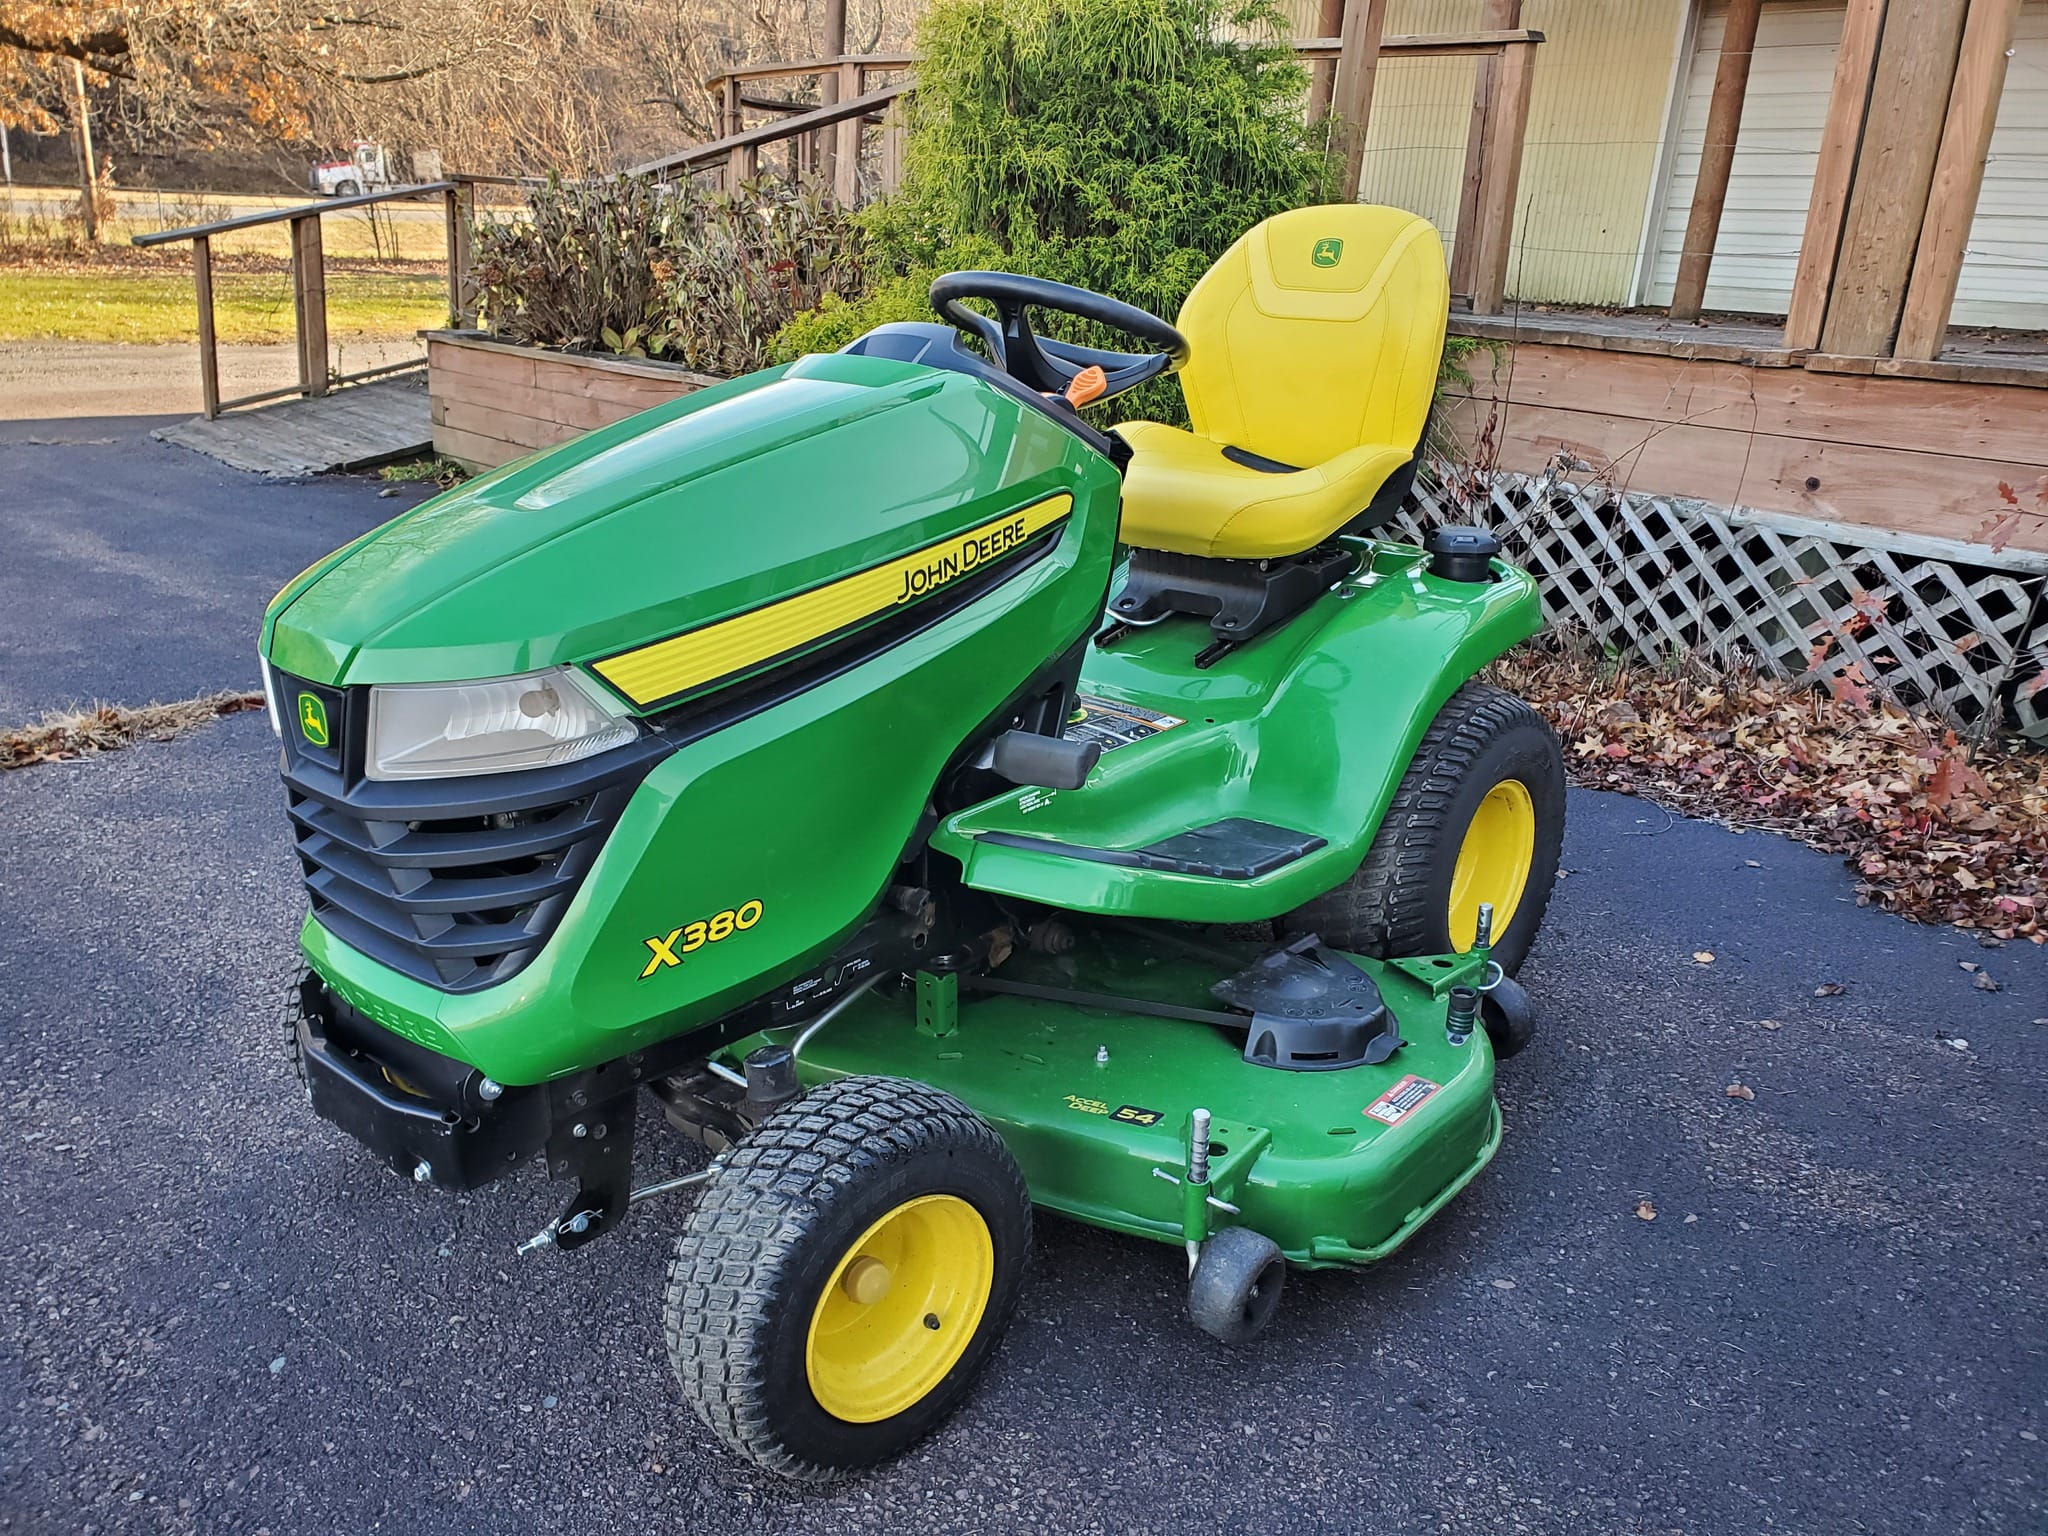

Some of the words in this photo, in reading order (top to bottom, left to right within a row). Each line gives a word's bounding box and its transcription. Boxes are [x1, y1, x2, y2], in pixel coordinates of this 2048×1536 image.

[898, 552, 959, 601] JOHN
[962, 518, 1027, 569] DEERE
[637, 898, 763, 981] X380
[1063, 1095, 1108, 1109] ACCEL
[1069, 1102, 1109, 1115] DEEP
[1116, 1107, 1156, 1124] 54
